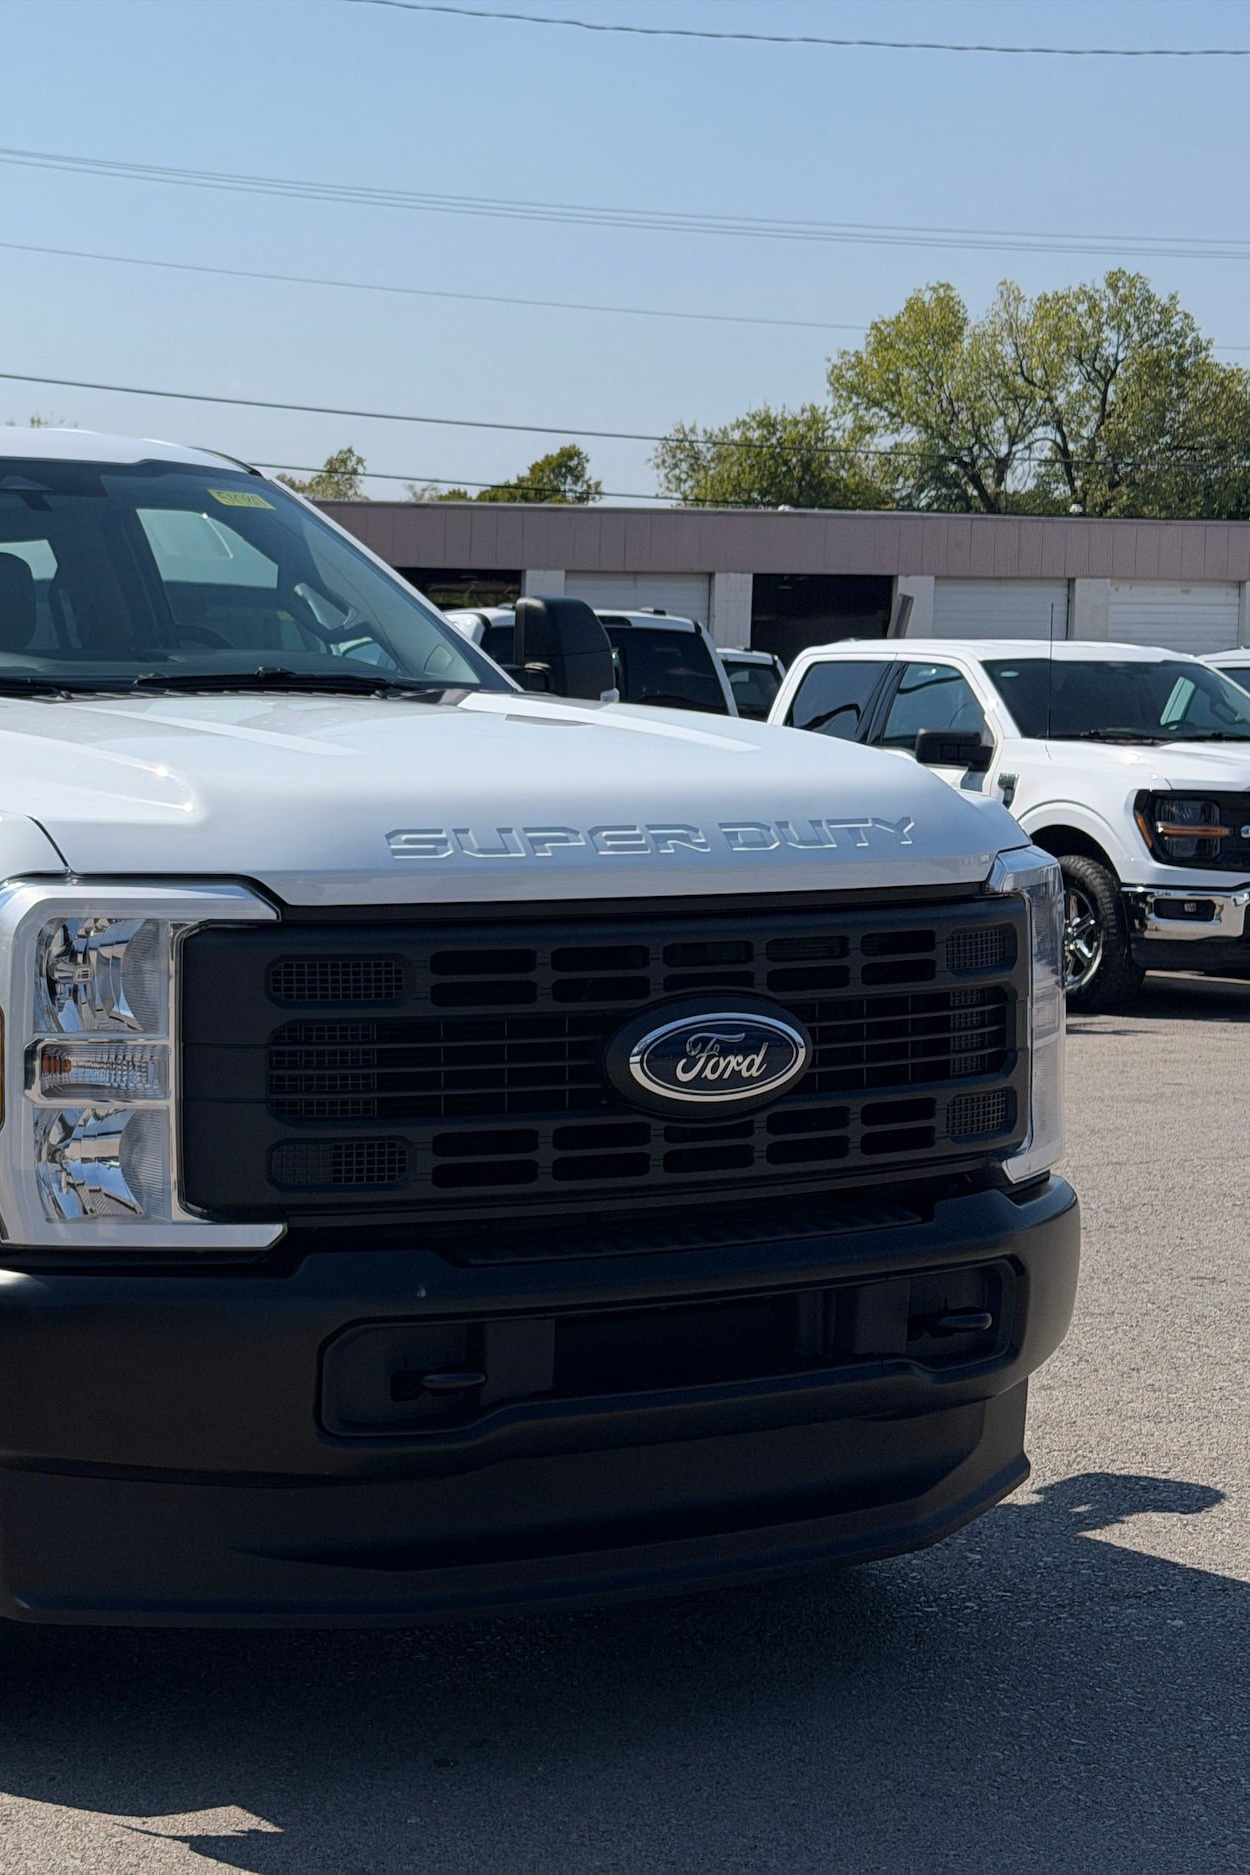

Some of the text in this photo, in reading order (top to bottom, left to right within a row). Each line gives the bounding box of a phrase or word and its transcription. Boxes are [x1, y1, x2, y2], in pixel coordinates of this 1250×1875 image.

[385, 816, 915, 858] SUPER DUTY
[676, 1032, 769, 1082] Ford
